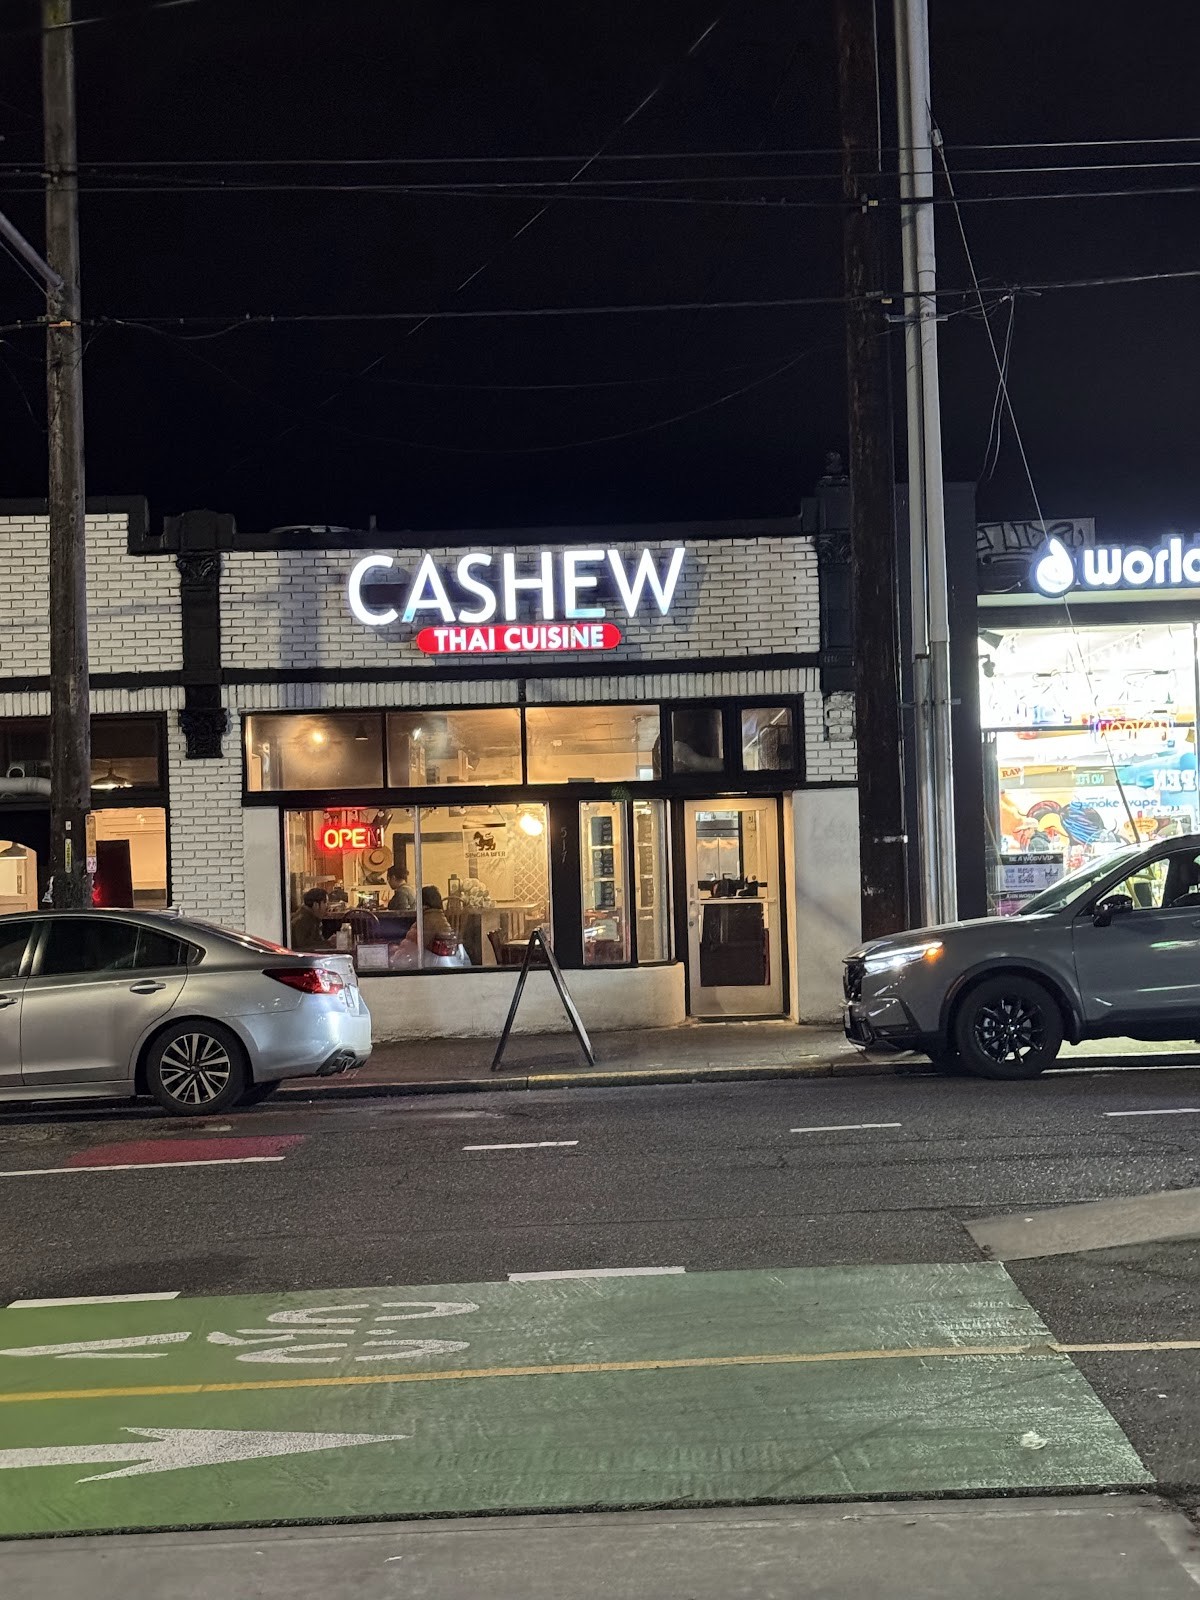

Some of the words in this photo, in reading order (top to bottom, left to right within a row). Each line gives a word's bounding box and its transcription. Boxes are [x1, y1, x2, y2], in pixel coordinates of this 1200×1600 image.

[348, 547, 686, 625] CASHEW
[434, 628, 496, 652] THAI
[503, 625, 605, 650] CUISINE
[1128, 798, 1159, 809] vape
[324, 827, 385, 849] OPEN
